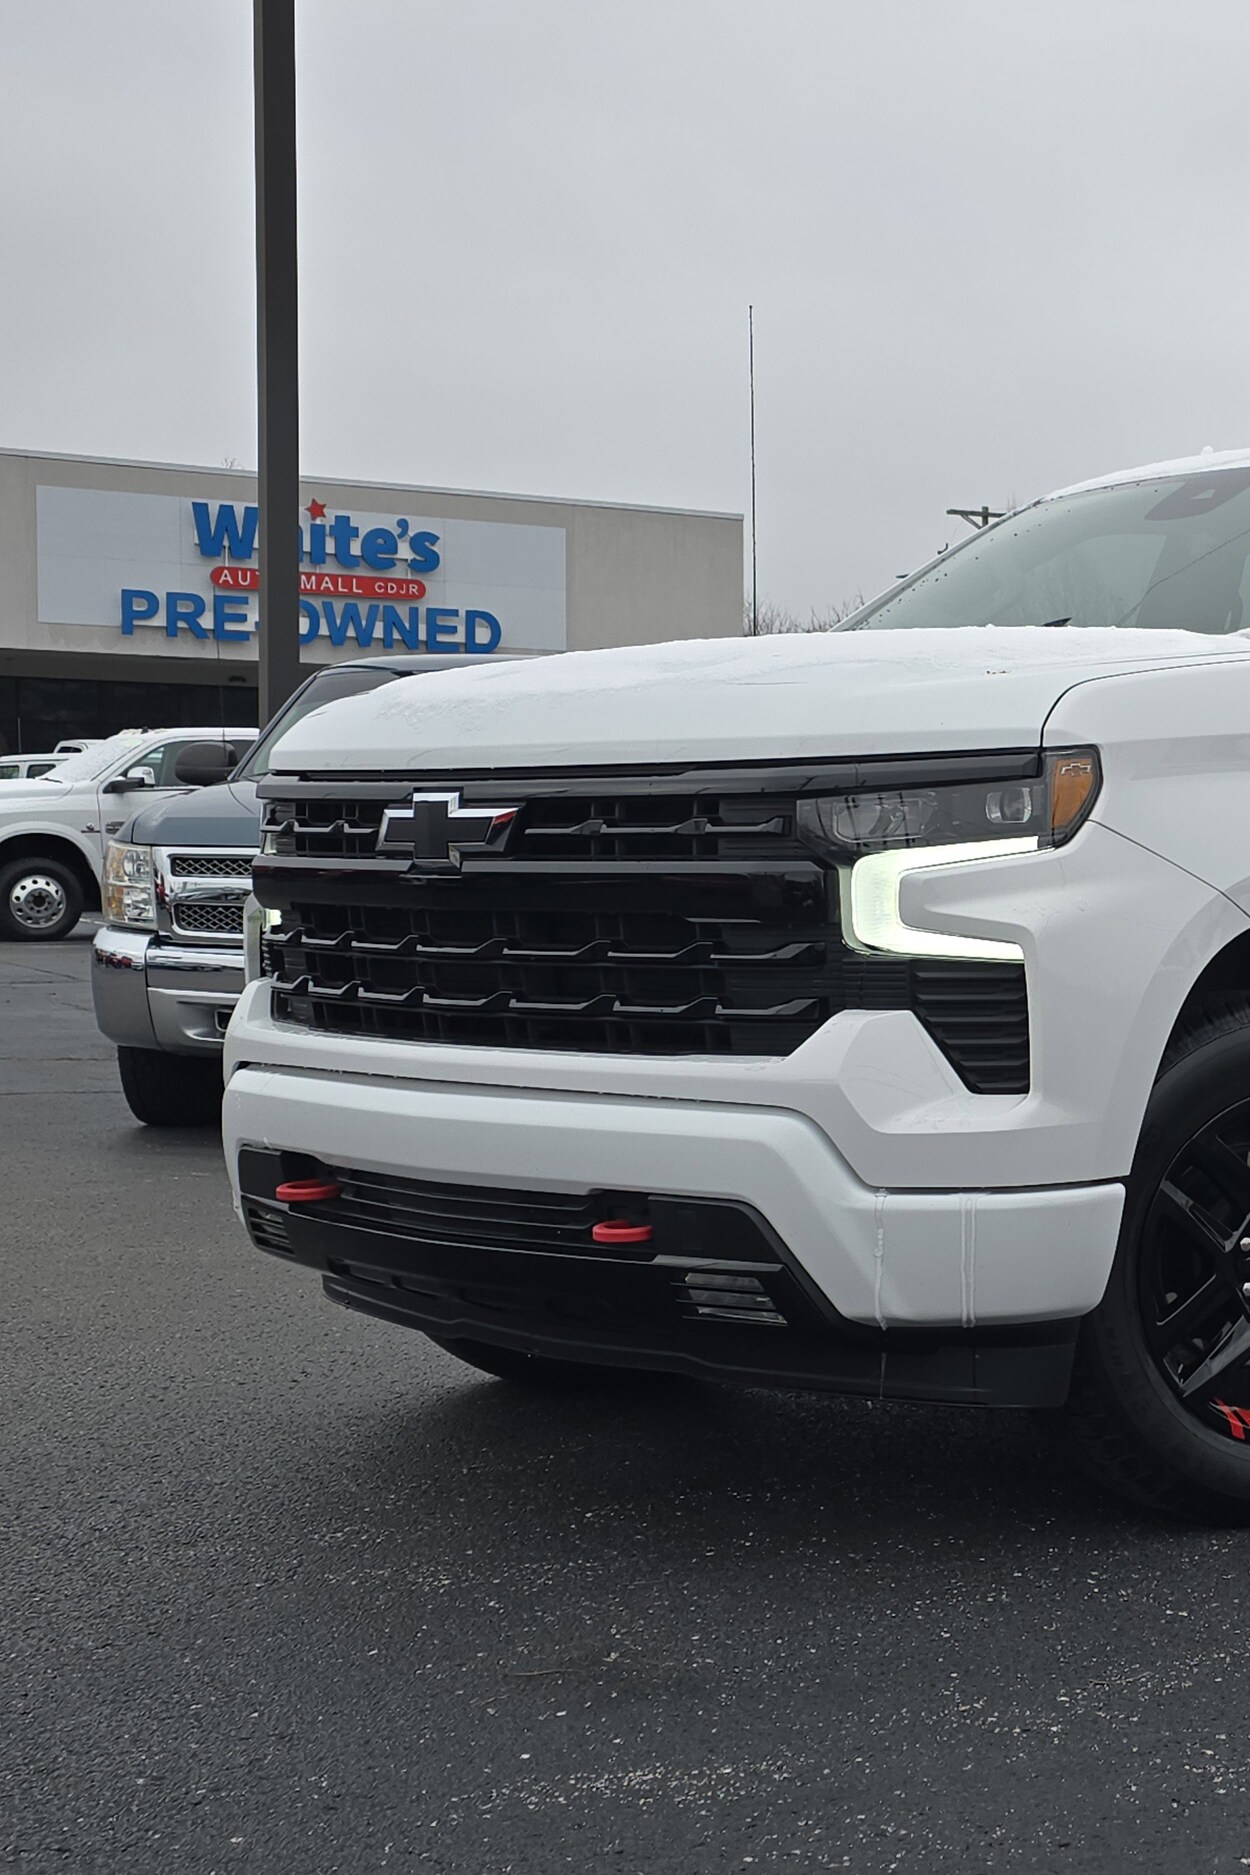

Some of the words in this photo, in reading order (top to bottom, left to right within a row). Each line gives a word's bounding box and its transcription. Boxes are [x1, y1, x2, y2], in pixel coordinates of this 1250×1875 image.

[191, 501, 441, 573] Wite's
[300, 574, 363, 594] MALL
[374, 581, 420, 596] CDJR
